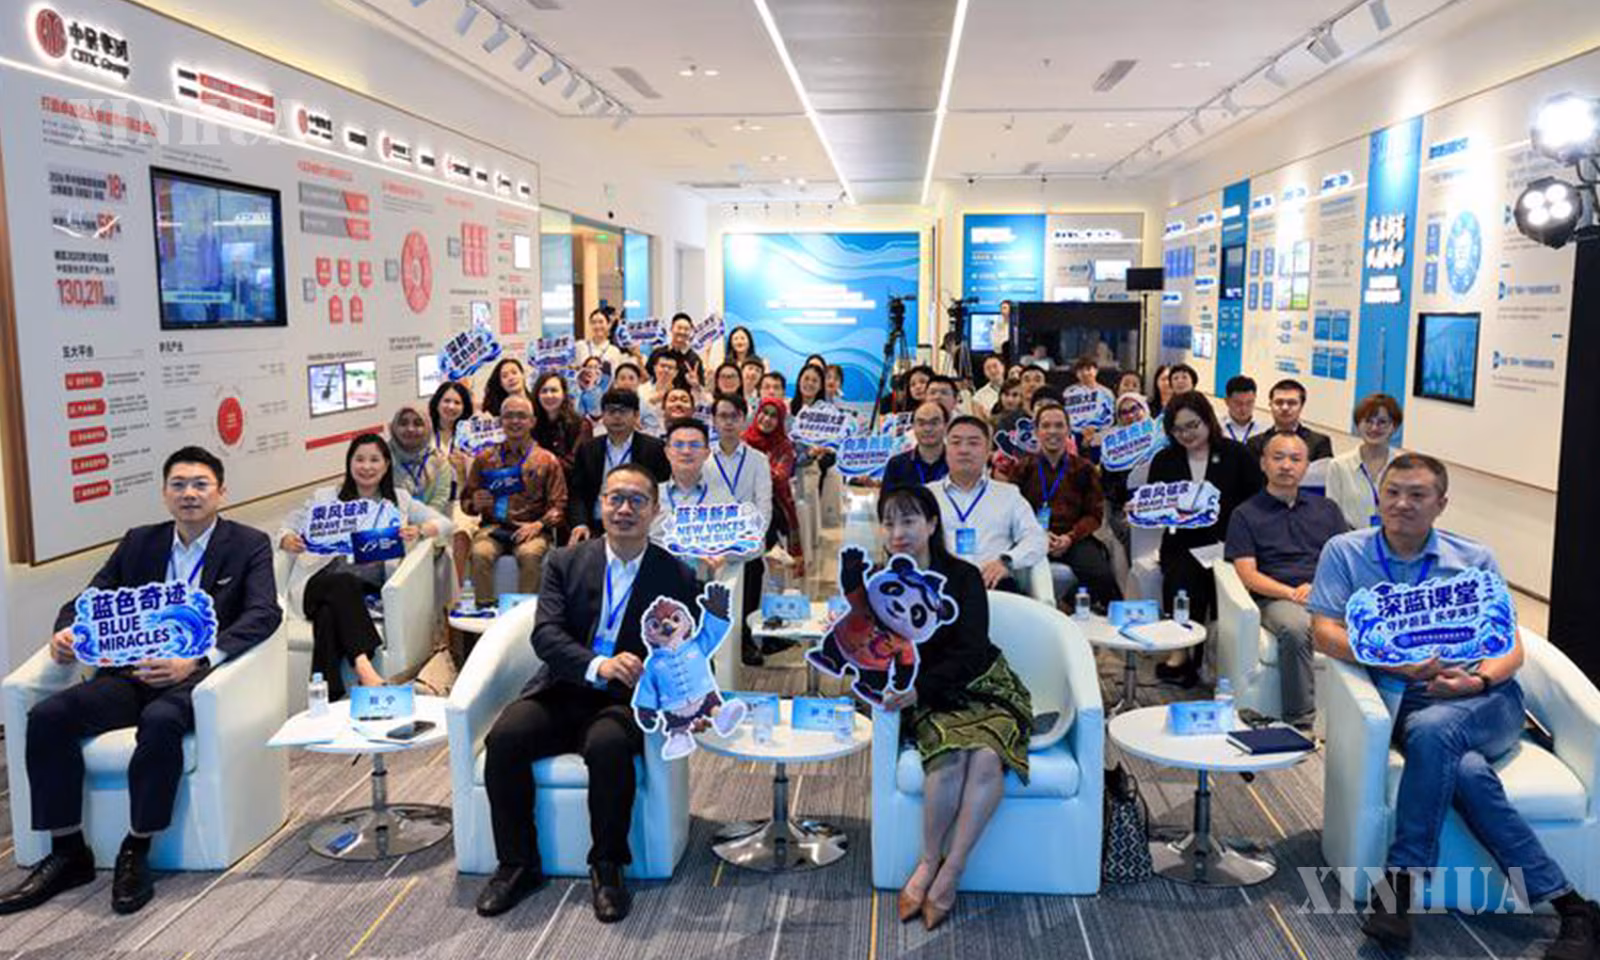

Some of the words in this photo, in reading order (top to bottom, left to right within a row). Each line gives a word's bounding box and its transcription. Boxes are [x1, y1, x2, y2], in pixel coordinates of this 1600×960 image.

[312, 501, 369, 520] 乘风破浪
[677, 504, 739, 525] 蓝海新声
[309, 519, 340, 532] BRAVE
[343, 517, 358, 527] THE
[677, 524, 704, 534] NEW
[706, 520, 747, 533] VOICES
[92, 581, 187, 621] 蓝色奇迹
[1377, 579, 1480, 618] 深蓝课堂
[98, 615, 142, 637] BLUE
[98, 627, 171, 653] MIRACLES
